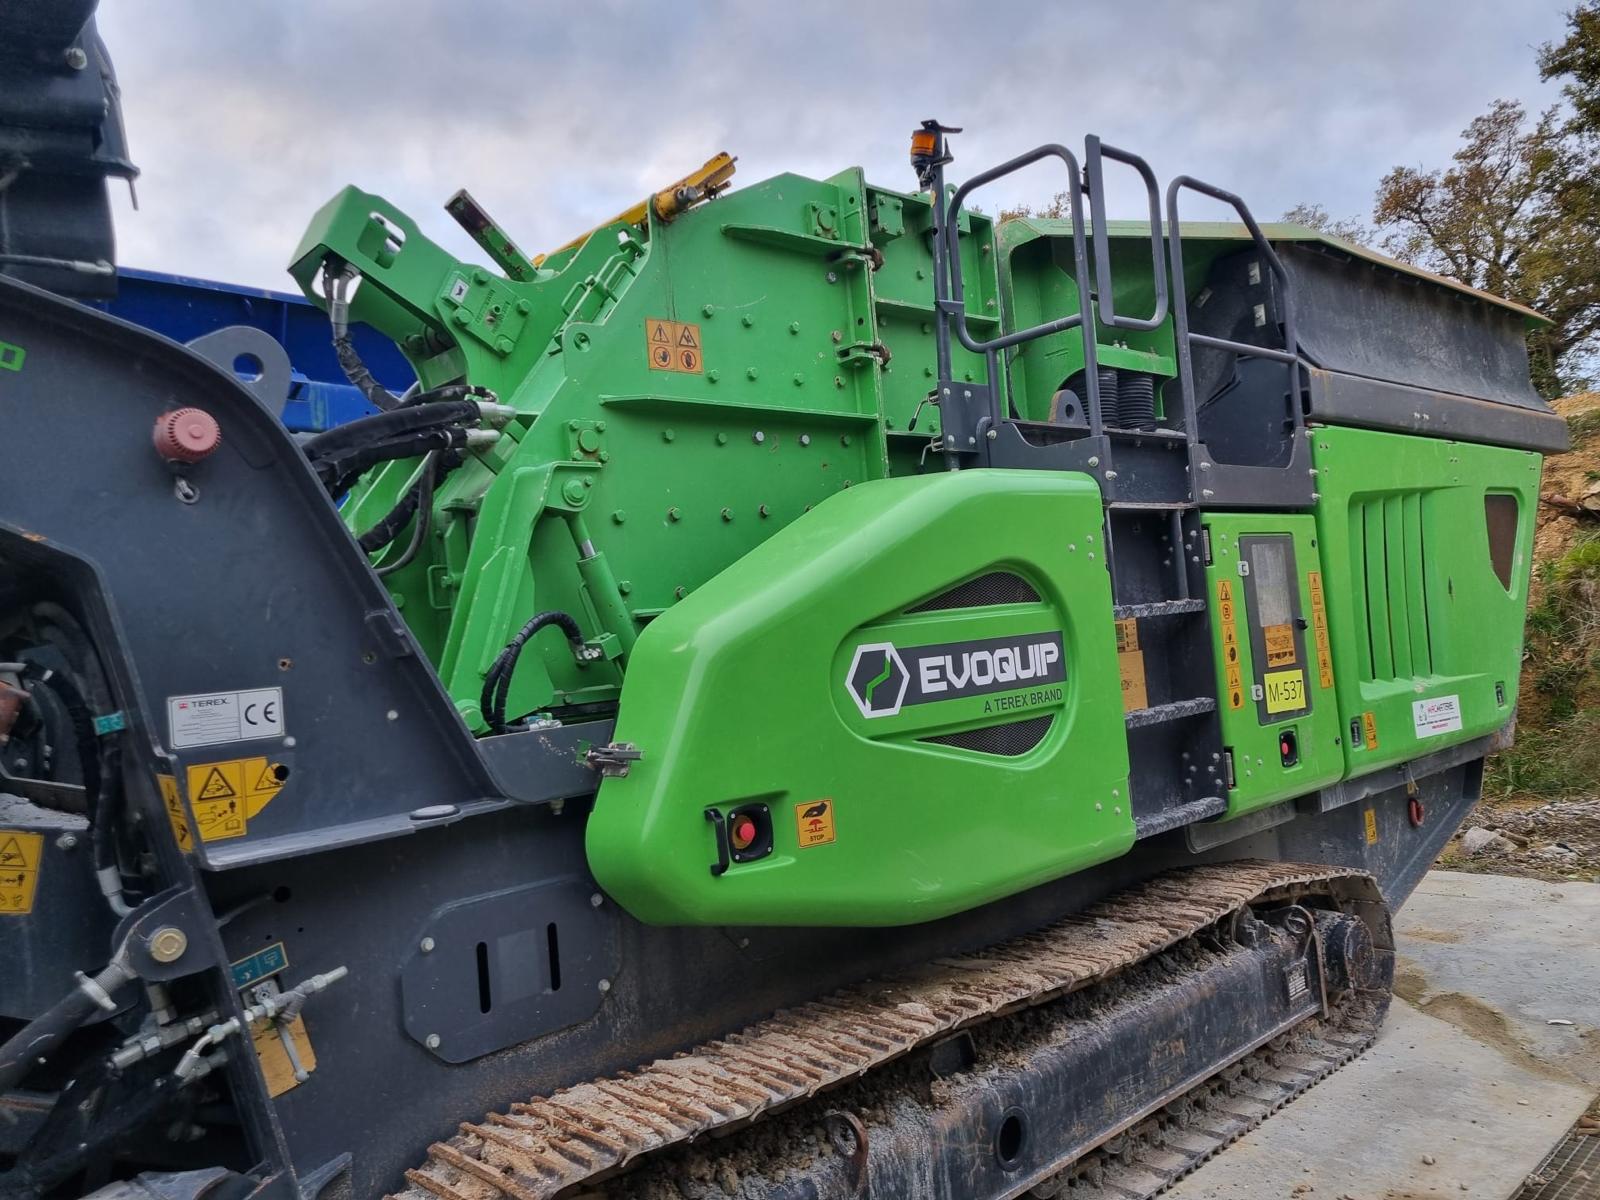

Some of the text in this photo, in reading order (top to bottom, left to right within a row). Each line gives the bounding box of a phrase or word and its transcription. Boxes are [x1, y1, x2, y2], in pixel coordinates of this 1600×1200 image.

[919, 642, 1059, 694] EVOQUIP
[984, 688, 1063, 713] A TEREX BRAND
[1268, 680, 1302, 702] M-537
[191, 698, 228, 708] TEREX
[809, 834, 825, 842] STOP
